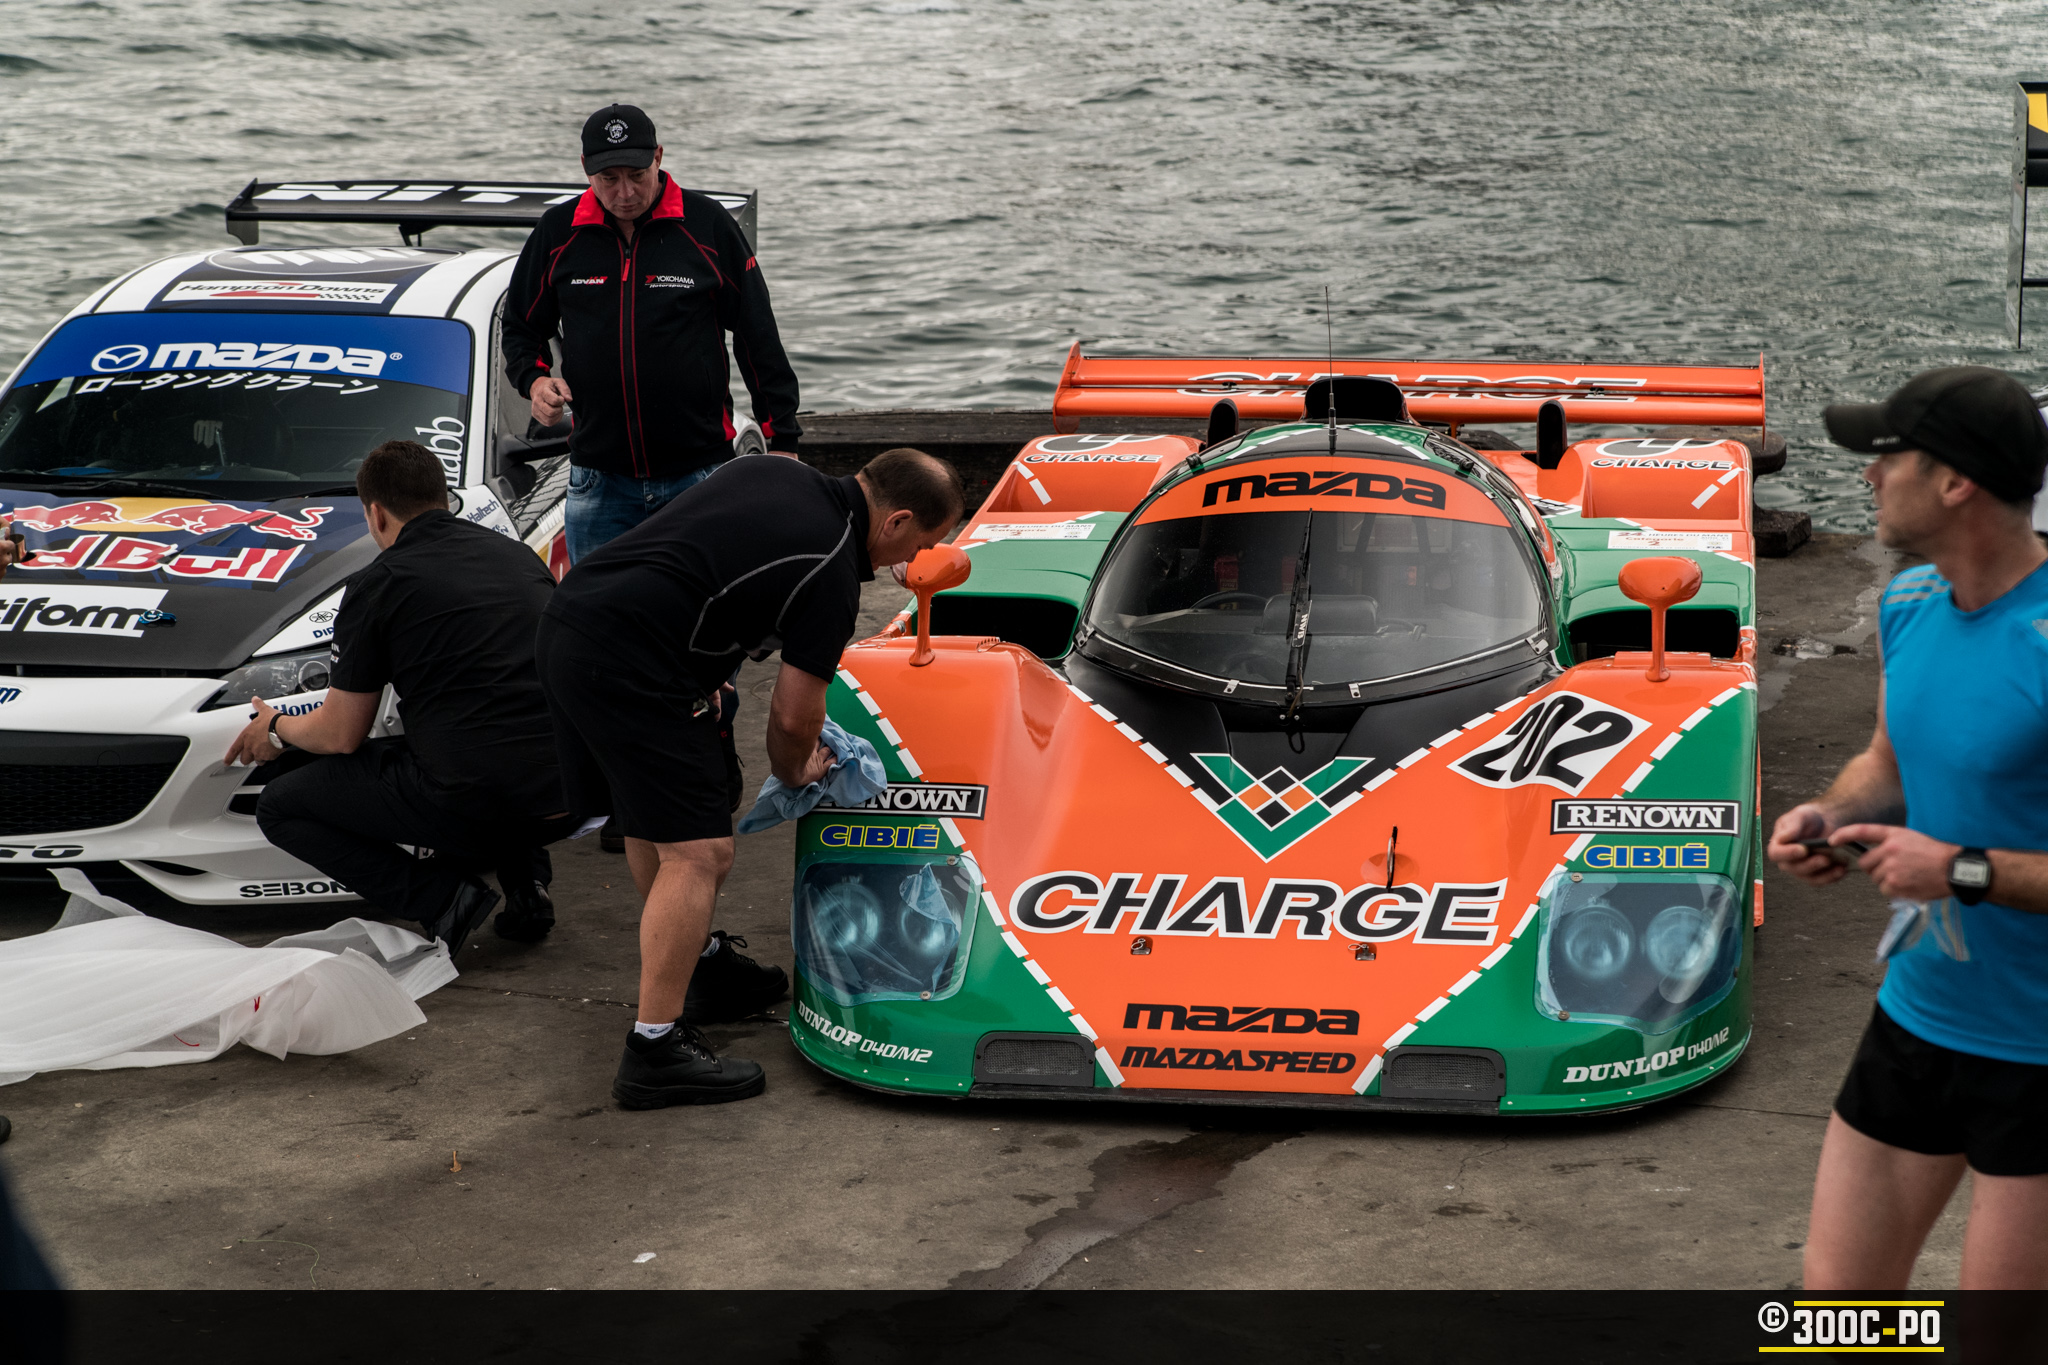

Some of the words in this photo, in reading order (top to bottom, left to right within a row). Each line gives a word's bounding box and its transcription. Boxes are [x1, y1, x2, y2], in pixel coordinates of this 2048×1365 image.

[178, 284, 297, 294] Hampton
[298, 284, 388, 295] Downs
[656, 275, 695, 285] YOKOHAMA
[1024, 453, 1164, 464] CHARGE
[1590, 457, 1735, 471] CHARGE
[466, 499, 500, 524] Haltech
[1456, 695, 1634, 788] 202
[819, 788, 971, 811] NOWN
[1566, 806, 1726, 829] RENOWN
[820, 824, 940, 849] CIBIÉ
[1584, 843, 1710, 869] CIBIÉ
[1009, 869, 1508, 945] CHARGE
[797, 1000, 862, 1047] DUNLOP
[1120, 1046, 1357, 1074] MAZDASPEED
[1562, 1046, 1686, 1083] DUNLOP
